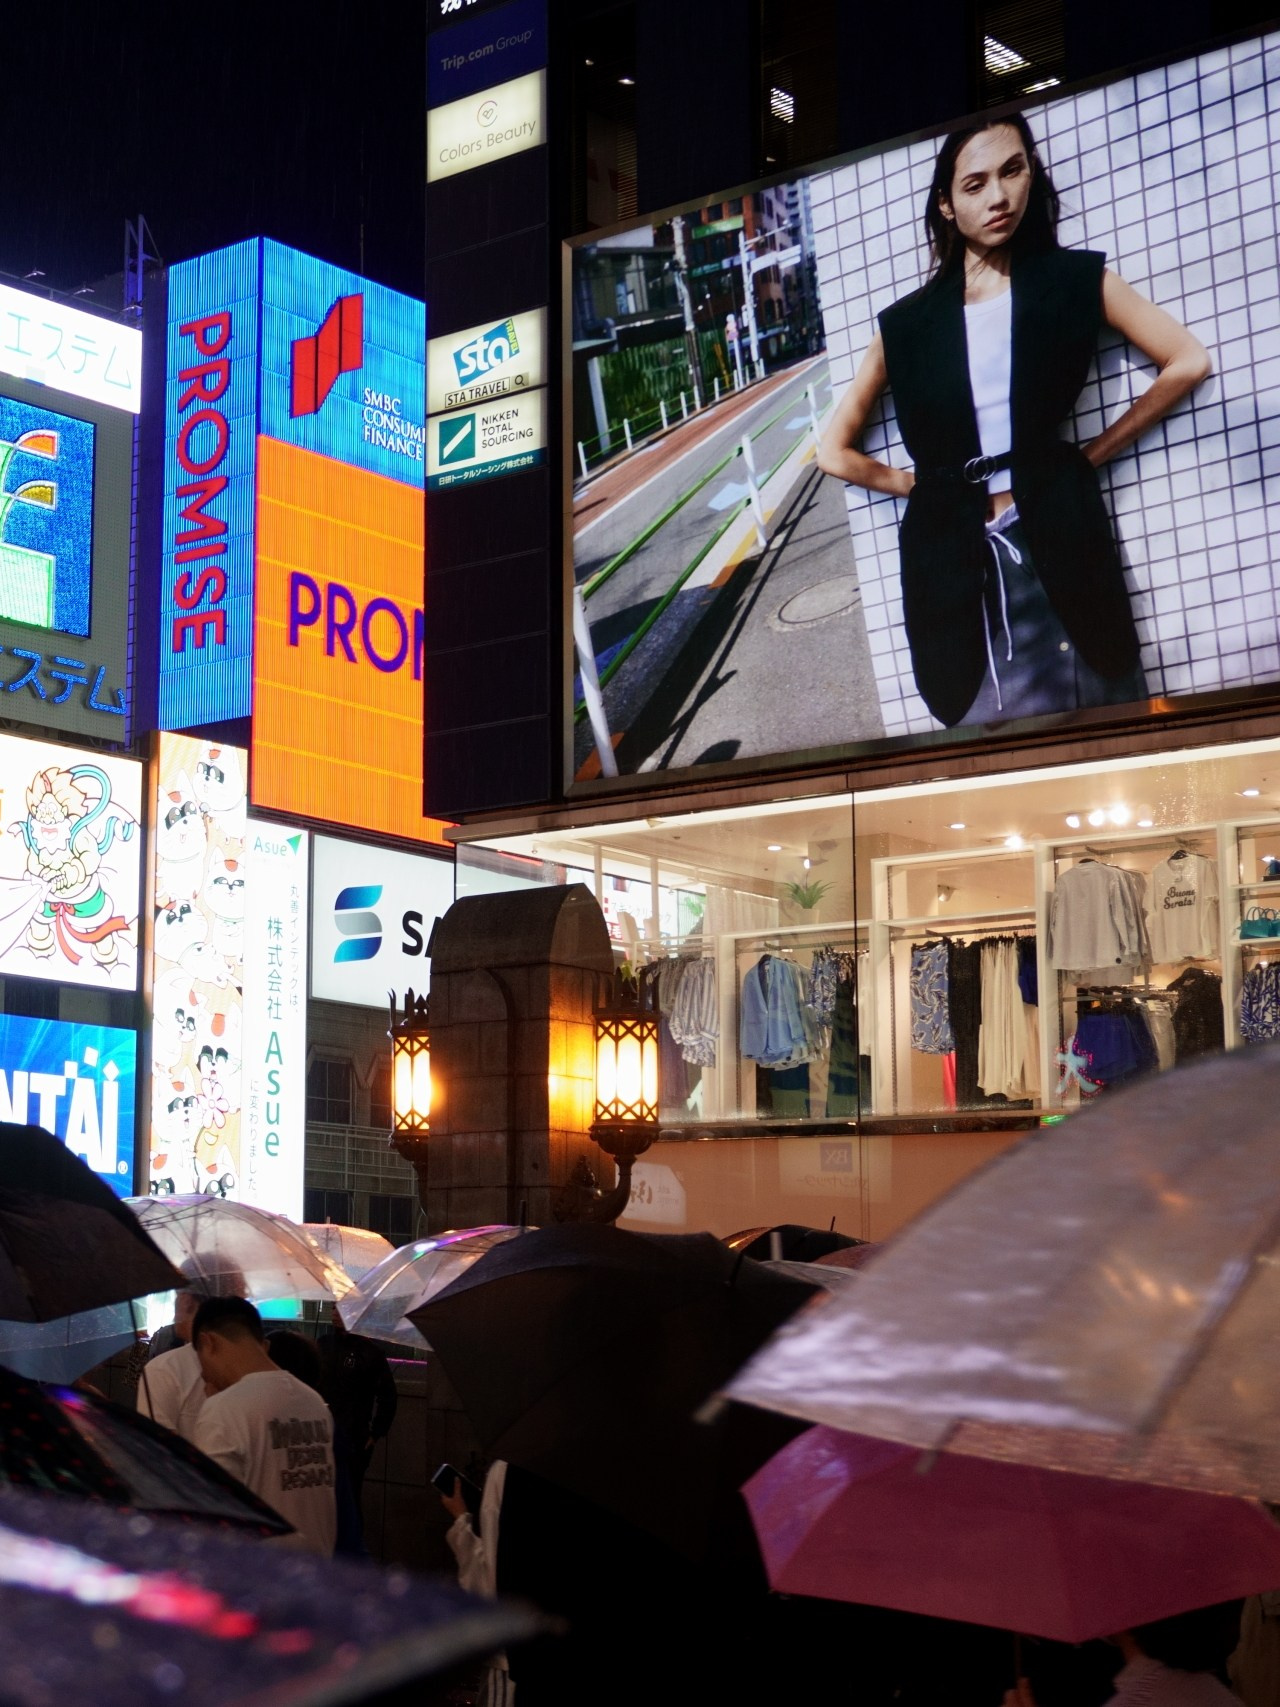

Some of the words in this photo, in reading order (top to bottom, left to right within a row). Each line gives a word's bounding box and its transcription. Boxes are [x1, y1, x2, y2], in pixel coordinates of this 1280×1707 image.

[441, 44, 494, 71] Trip.com
[496, 30, 532, 51] Group
[439, 139, 482, 163] Colors
[487, 120, 536, 148] Beauty
[505, 319, 519, 354] TRAVEL
[459, 334, 511, 378] sta
[364, 387, 401, 415] SMBC
[447, 391, 466, 406] STA
[469, 380, 508, 401] TRAVEL
[481, 408, 519, 425] NIKKEN
[481, 422, 513, 436] TOTAL
[364, 425, 423, 461] FINANCE
[481, 428, 534, 449] SOURCING
[172, 311, 231, 653] PROMISE
[438, 455, 534, 486] 日研トータルソーシング株式会社
[287, 571, 424, 681] PRO
[253, 836, 288, 857] Asue
[267, 914, 284, 1020] 株式会社
[264, 1031, 284, 1157] Asue
